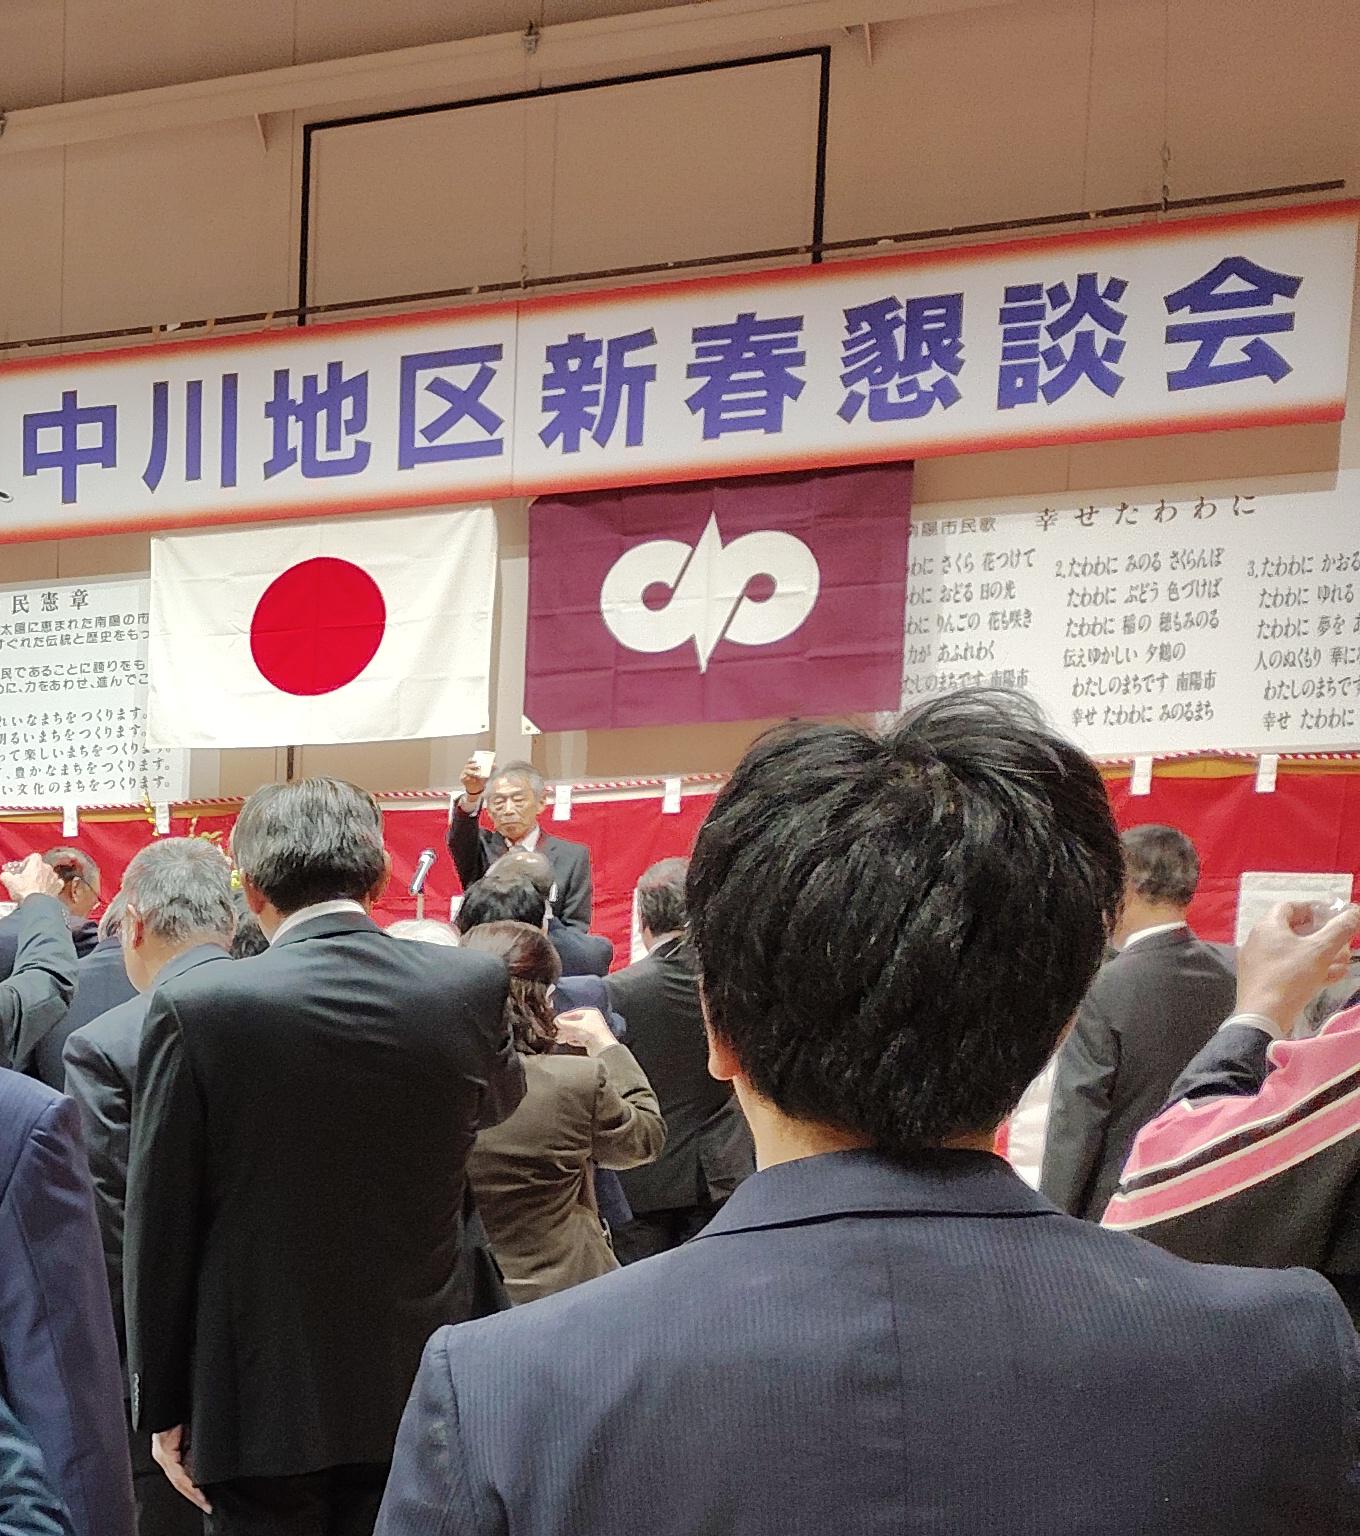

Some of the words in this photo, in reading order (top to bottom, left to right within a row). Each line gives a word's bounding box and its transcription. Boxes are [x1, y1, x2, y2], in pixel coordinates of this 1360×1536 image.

[23, 256, 1304, 504] 中川地区新春懇談会
[941, 552, 975, 574] さくら
[983, 547, 1036, 572] 花つけて
[1125, 551, 1162, 572] みのる
[1169, 548, 1225, 571] さくらんぼ
[940, 582, 973, 603] おどる
[1066, 586, 1117, 608] たわわに
[1124, 581, 1159, 603] ぶどう
[1168, 577, 1223, 602] 色づけば
[1259, 585, 1309, 608] たわわに
[1318, 583, 1354, 603] ゆれる
[1065, 616, 1115, 638] たわわに
[1257, 616, 1310, 639] たわわに
[1317, 614, 1345, 636] 夢を
[1254, 646, 1321, 671] 人のぬくもり
[1329, 646, 1360, 667] 華に
[1072, 672, 1169, 697] わたしのまちです
[1176, 669, 1217, 692] 南陽市
[1072, 706, 1098, 727] 幸せ
[1103, 704, 1153, 726] たわわに
[1159, 700, 1214, 722] みのるまち
[1263, 710, 1291, 732] 幸せ
[1300, 707, 1354, 729] たわわに
